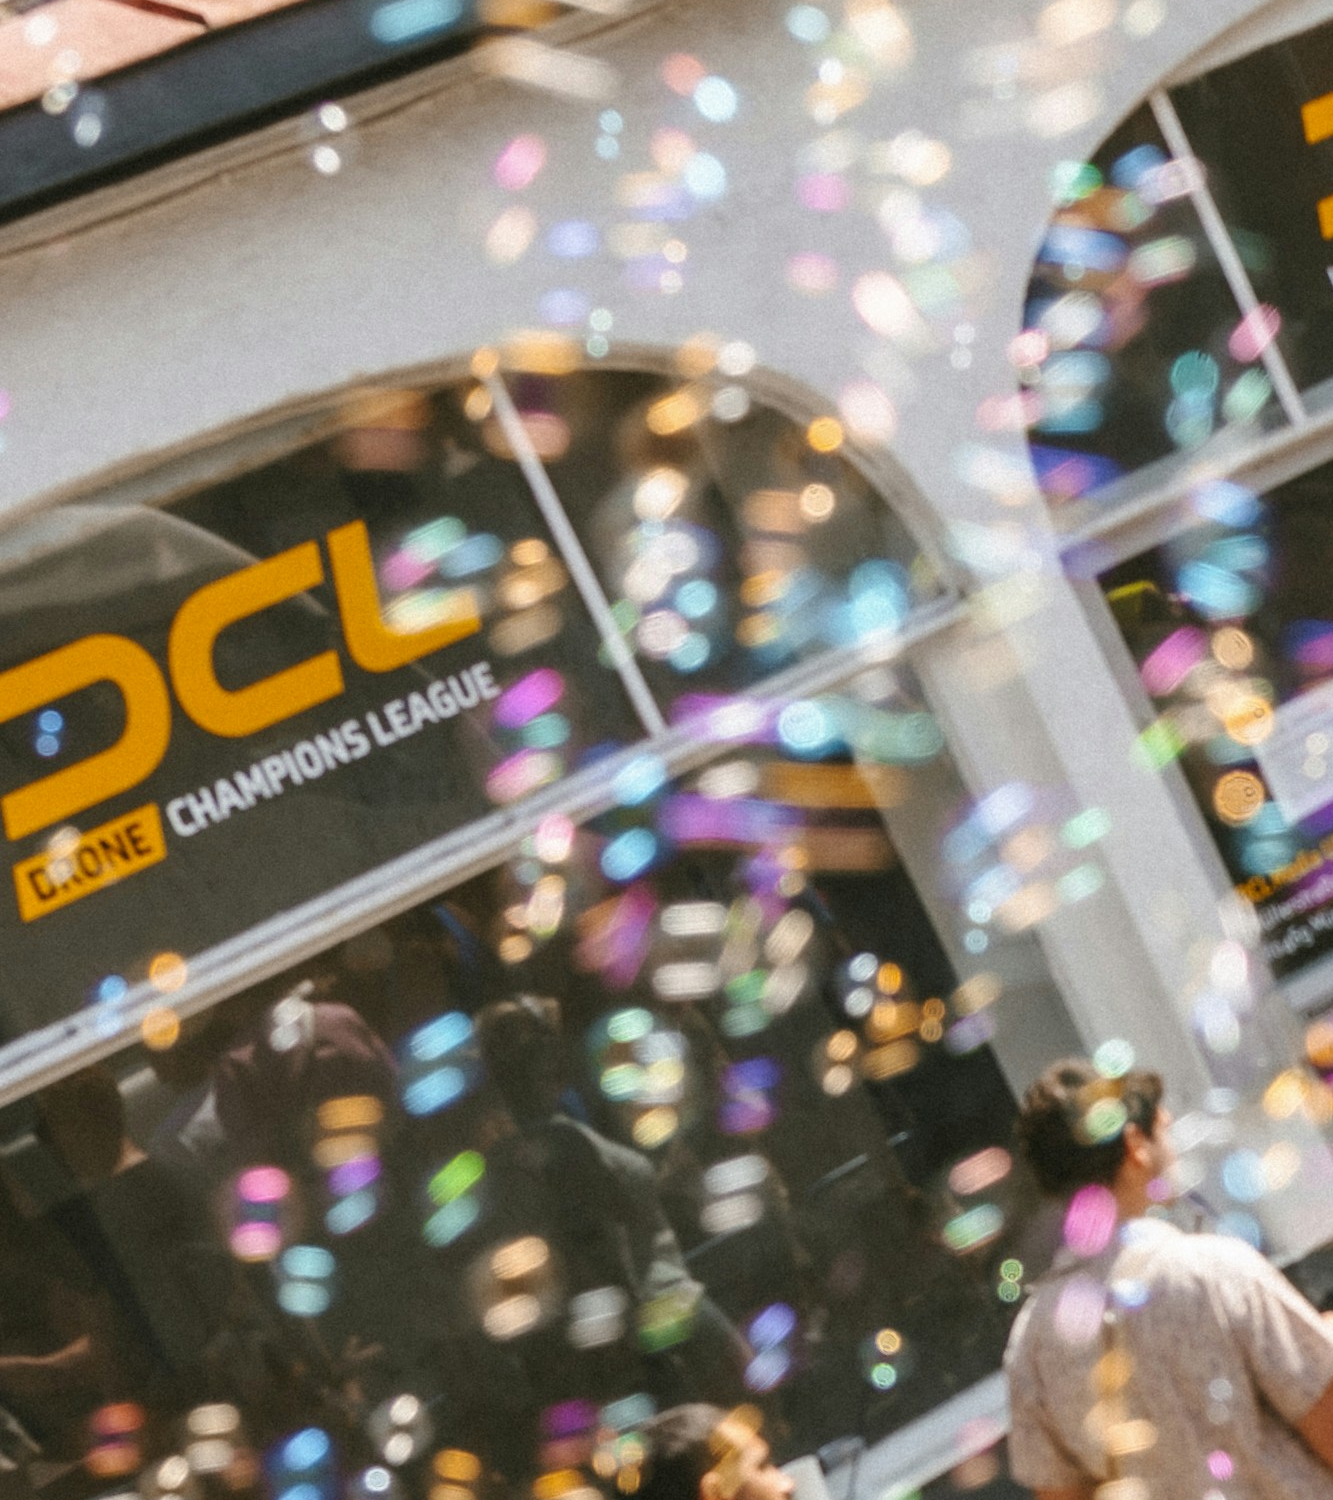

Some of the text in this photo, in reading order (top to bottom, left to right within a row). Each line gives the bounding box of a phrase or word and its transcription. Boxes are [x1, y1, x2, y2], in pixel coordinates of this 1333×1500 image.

[0, 519, 483, 842] DCL
[28, 662, 502, 902] DRONE CHAMPIONS LEAGUE
